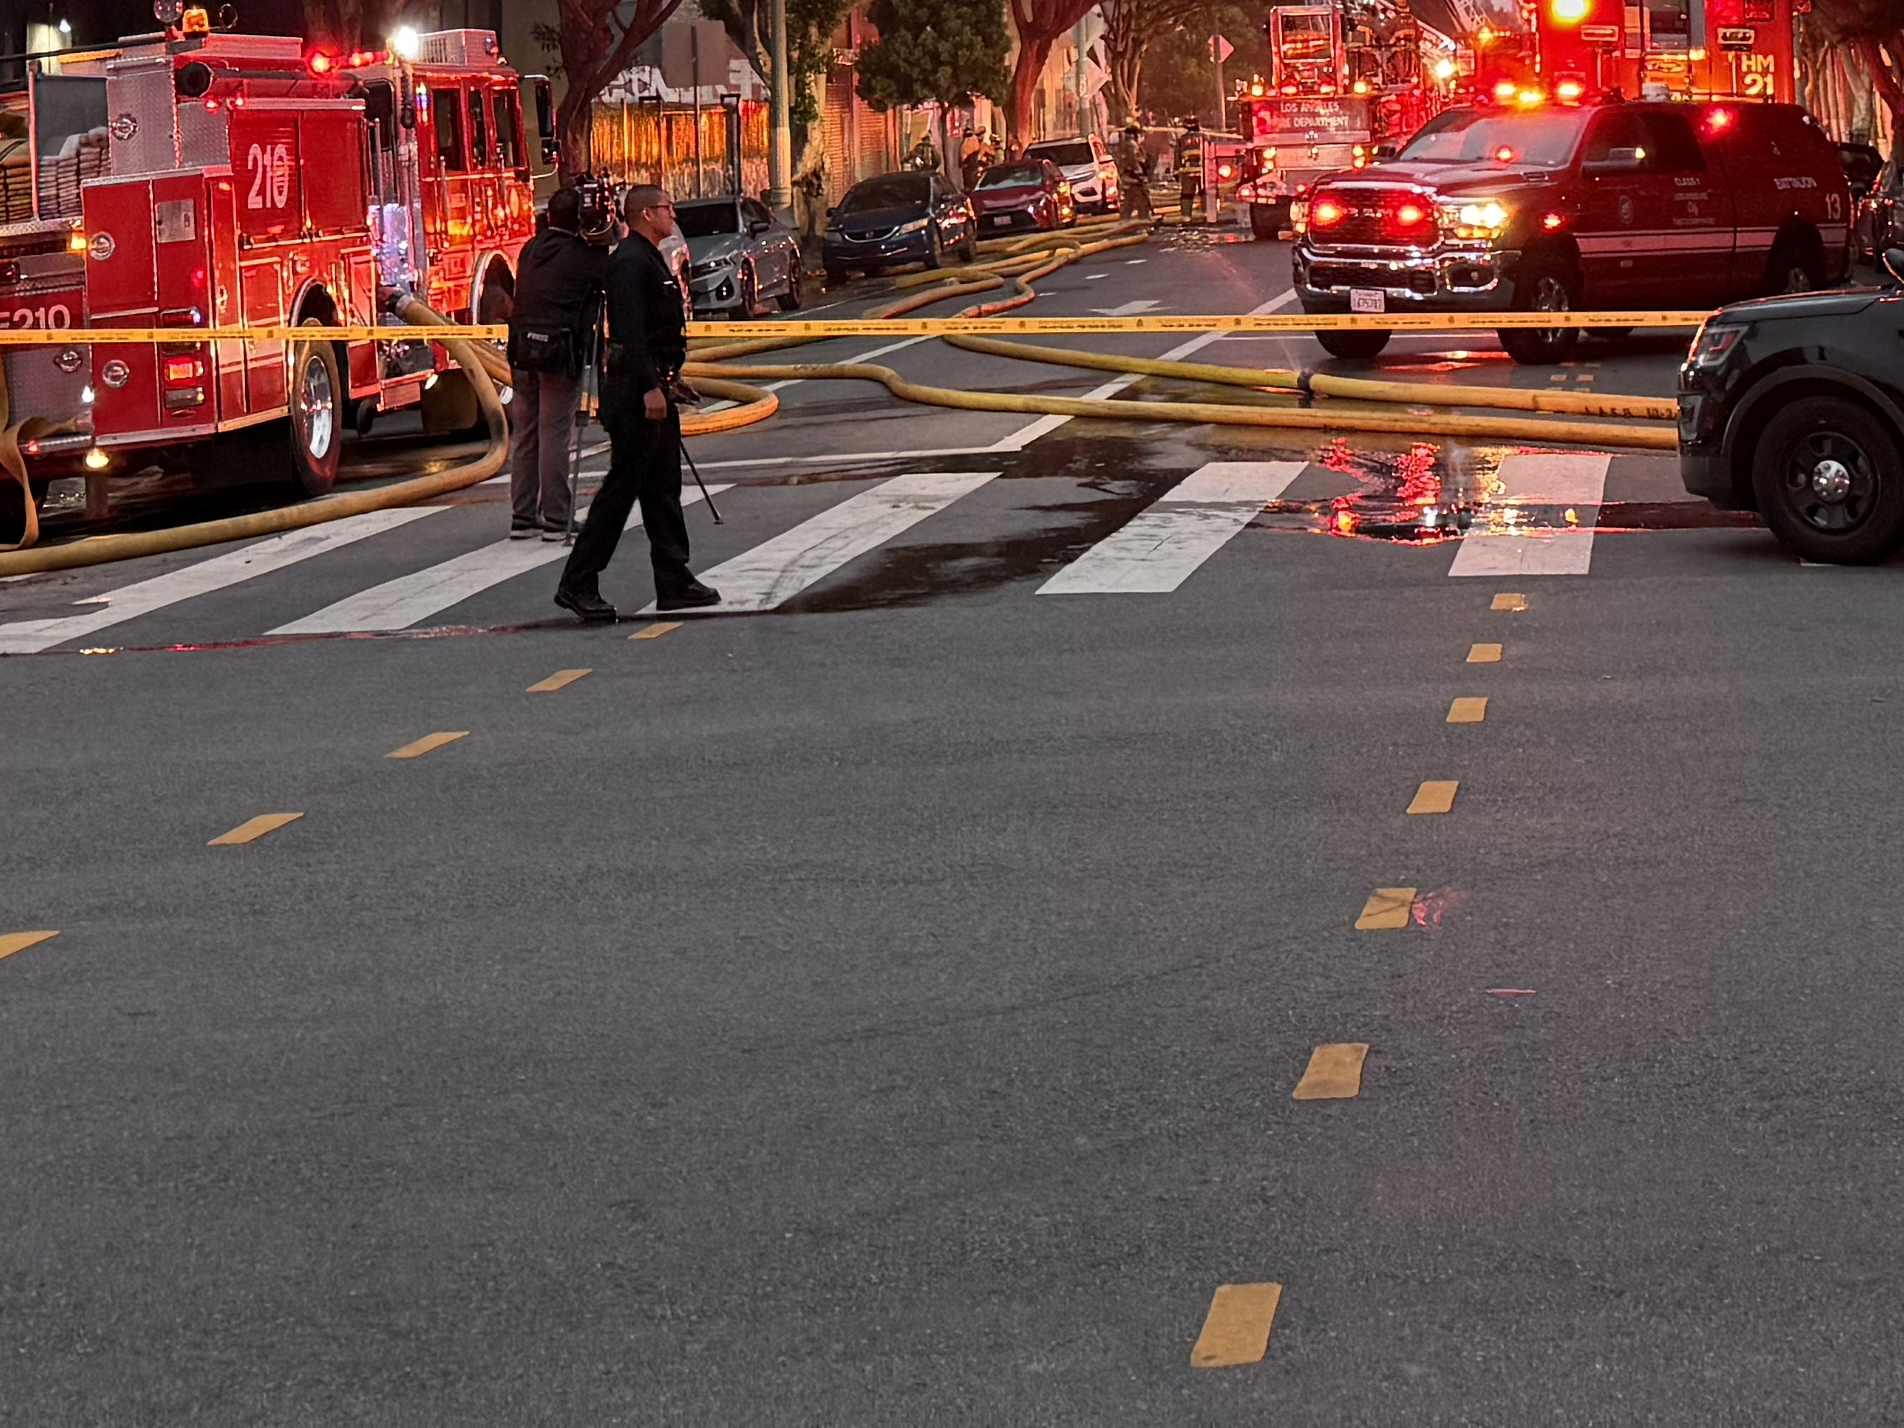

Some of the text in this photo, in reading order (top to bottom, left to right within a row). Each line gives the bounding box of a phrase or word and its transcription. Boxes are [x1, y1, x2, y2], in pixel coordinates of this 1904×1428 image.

[1741, 55, 1774, 73] HM
[1744, 74, 1774, 95] 21
[1280, 101, 1298, 113] LOS
[247, 143, 289, 210] 210
[1825, 193, 1841, 220] 13
